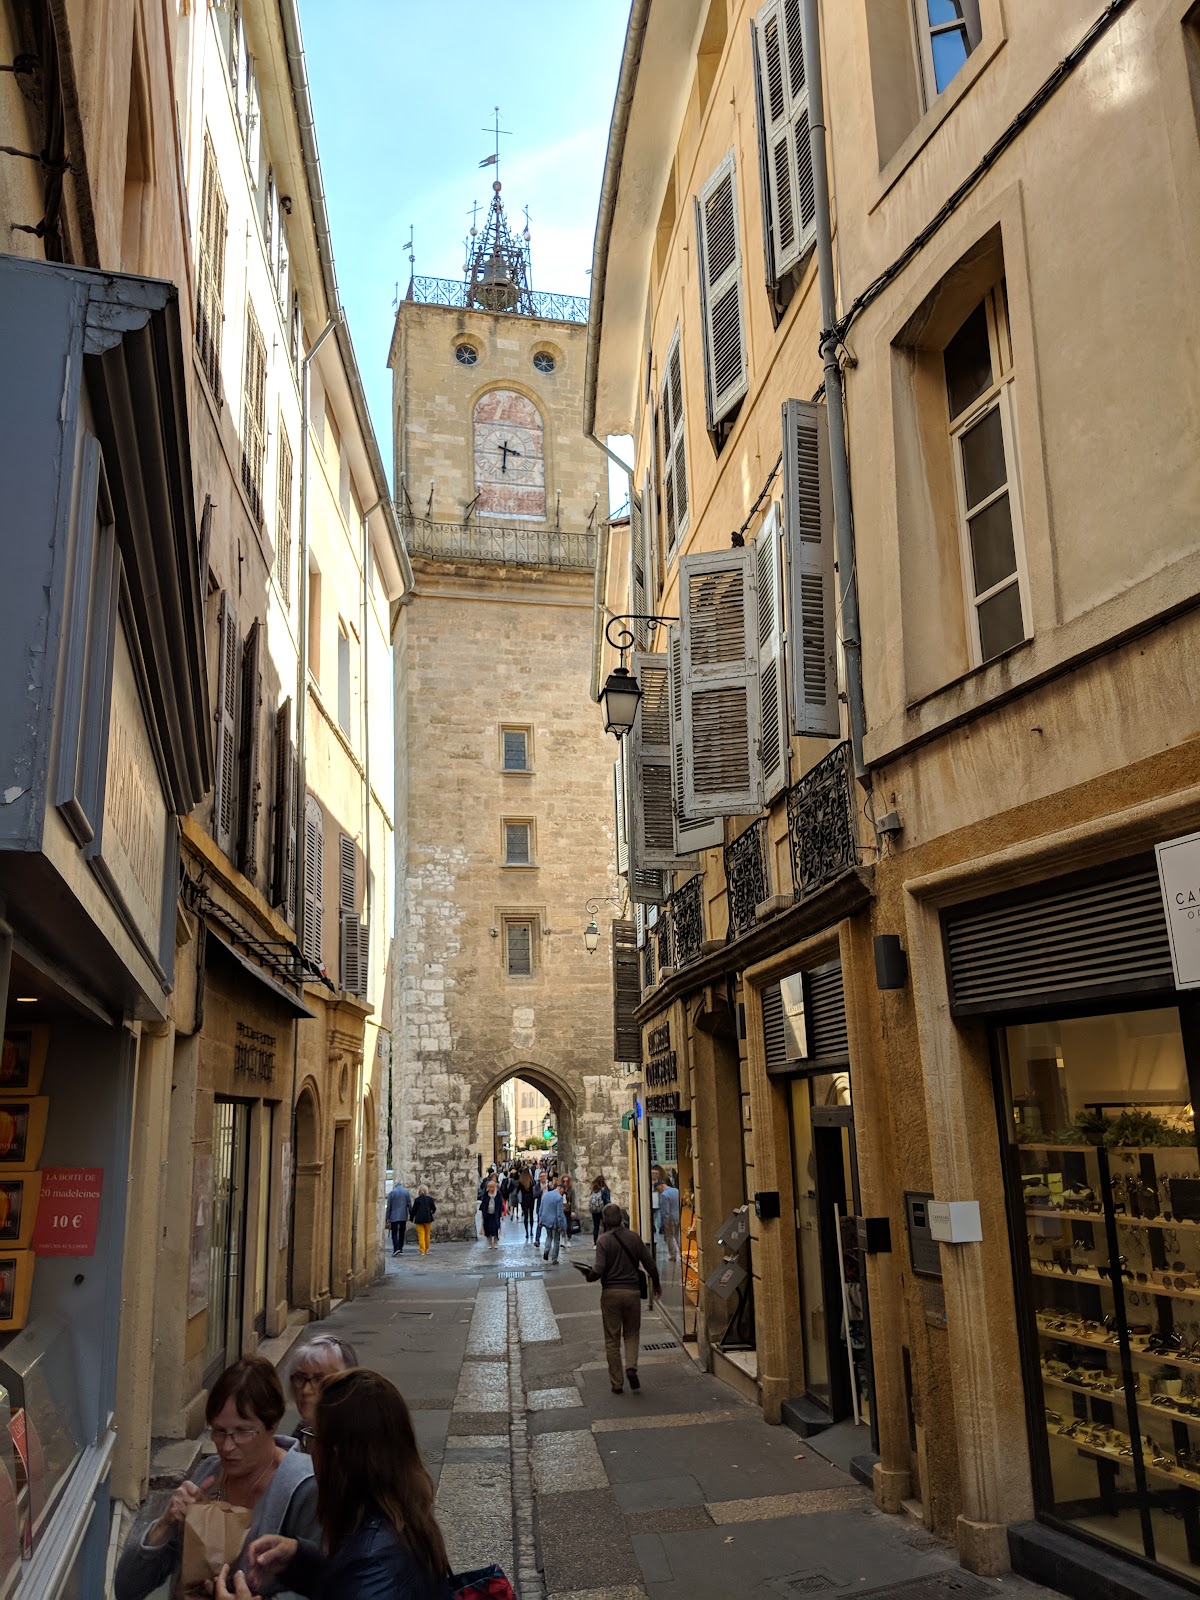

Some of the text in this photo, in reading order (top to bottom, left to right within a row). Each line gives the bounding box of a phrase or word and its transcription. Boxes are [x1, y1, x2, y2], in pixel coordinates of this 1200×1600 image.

[1176, 888, 1200, 905] CA
[46, 1173, 96, 1182] LA BOITE DE
[40, 1188, 100, 1198] 20 madeleines
[53, 1214, 83, 1228] 10 €
